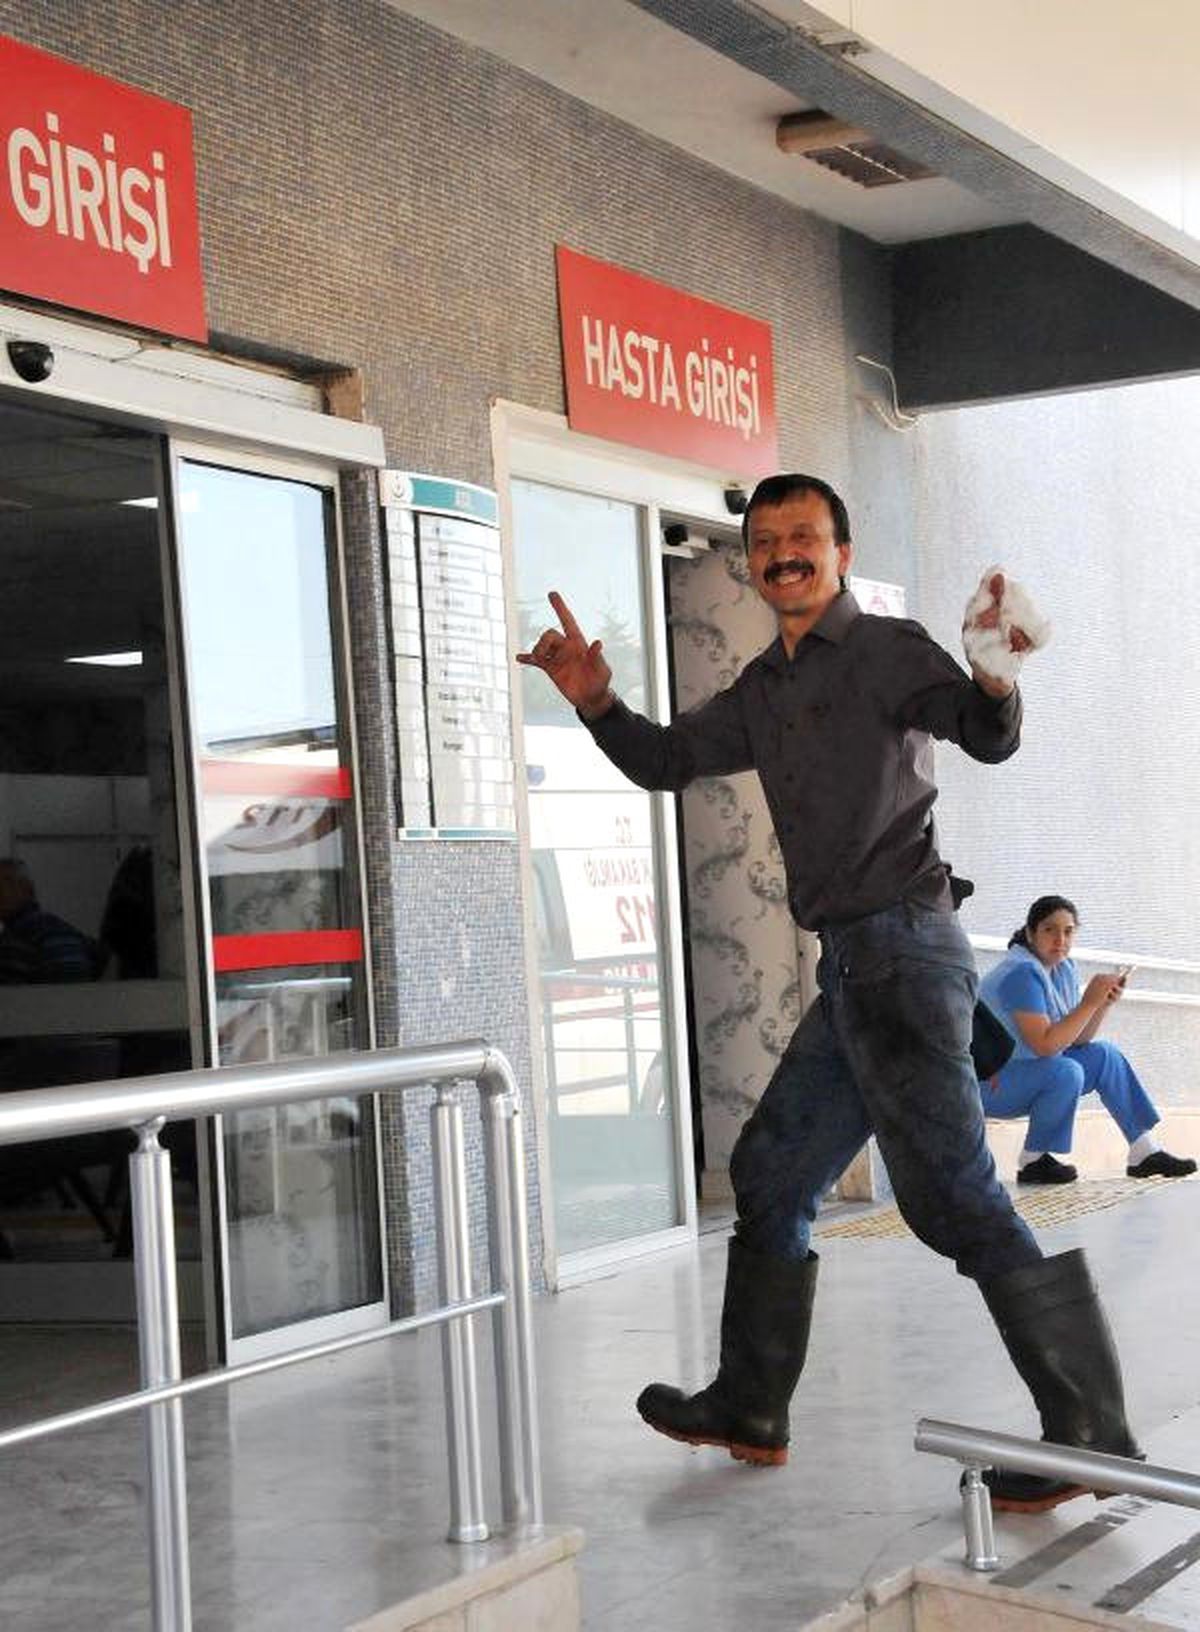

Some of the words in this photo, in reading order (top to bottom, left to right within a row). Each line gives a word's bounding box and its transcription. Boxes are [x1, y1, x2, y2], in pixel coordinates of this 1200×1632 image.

[7, 111, 172, 275] GİRİŞİ
[582, 315, 682, 411] HASTA
[686, 338, 761, 440] GİRİŞİ
